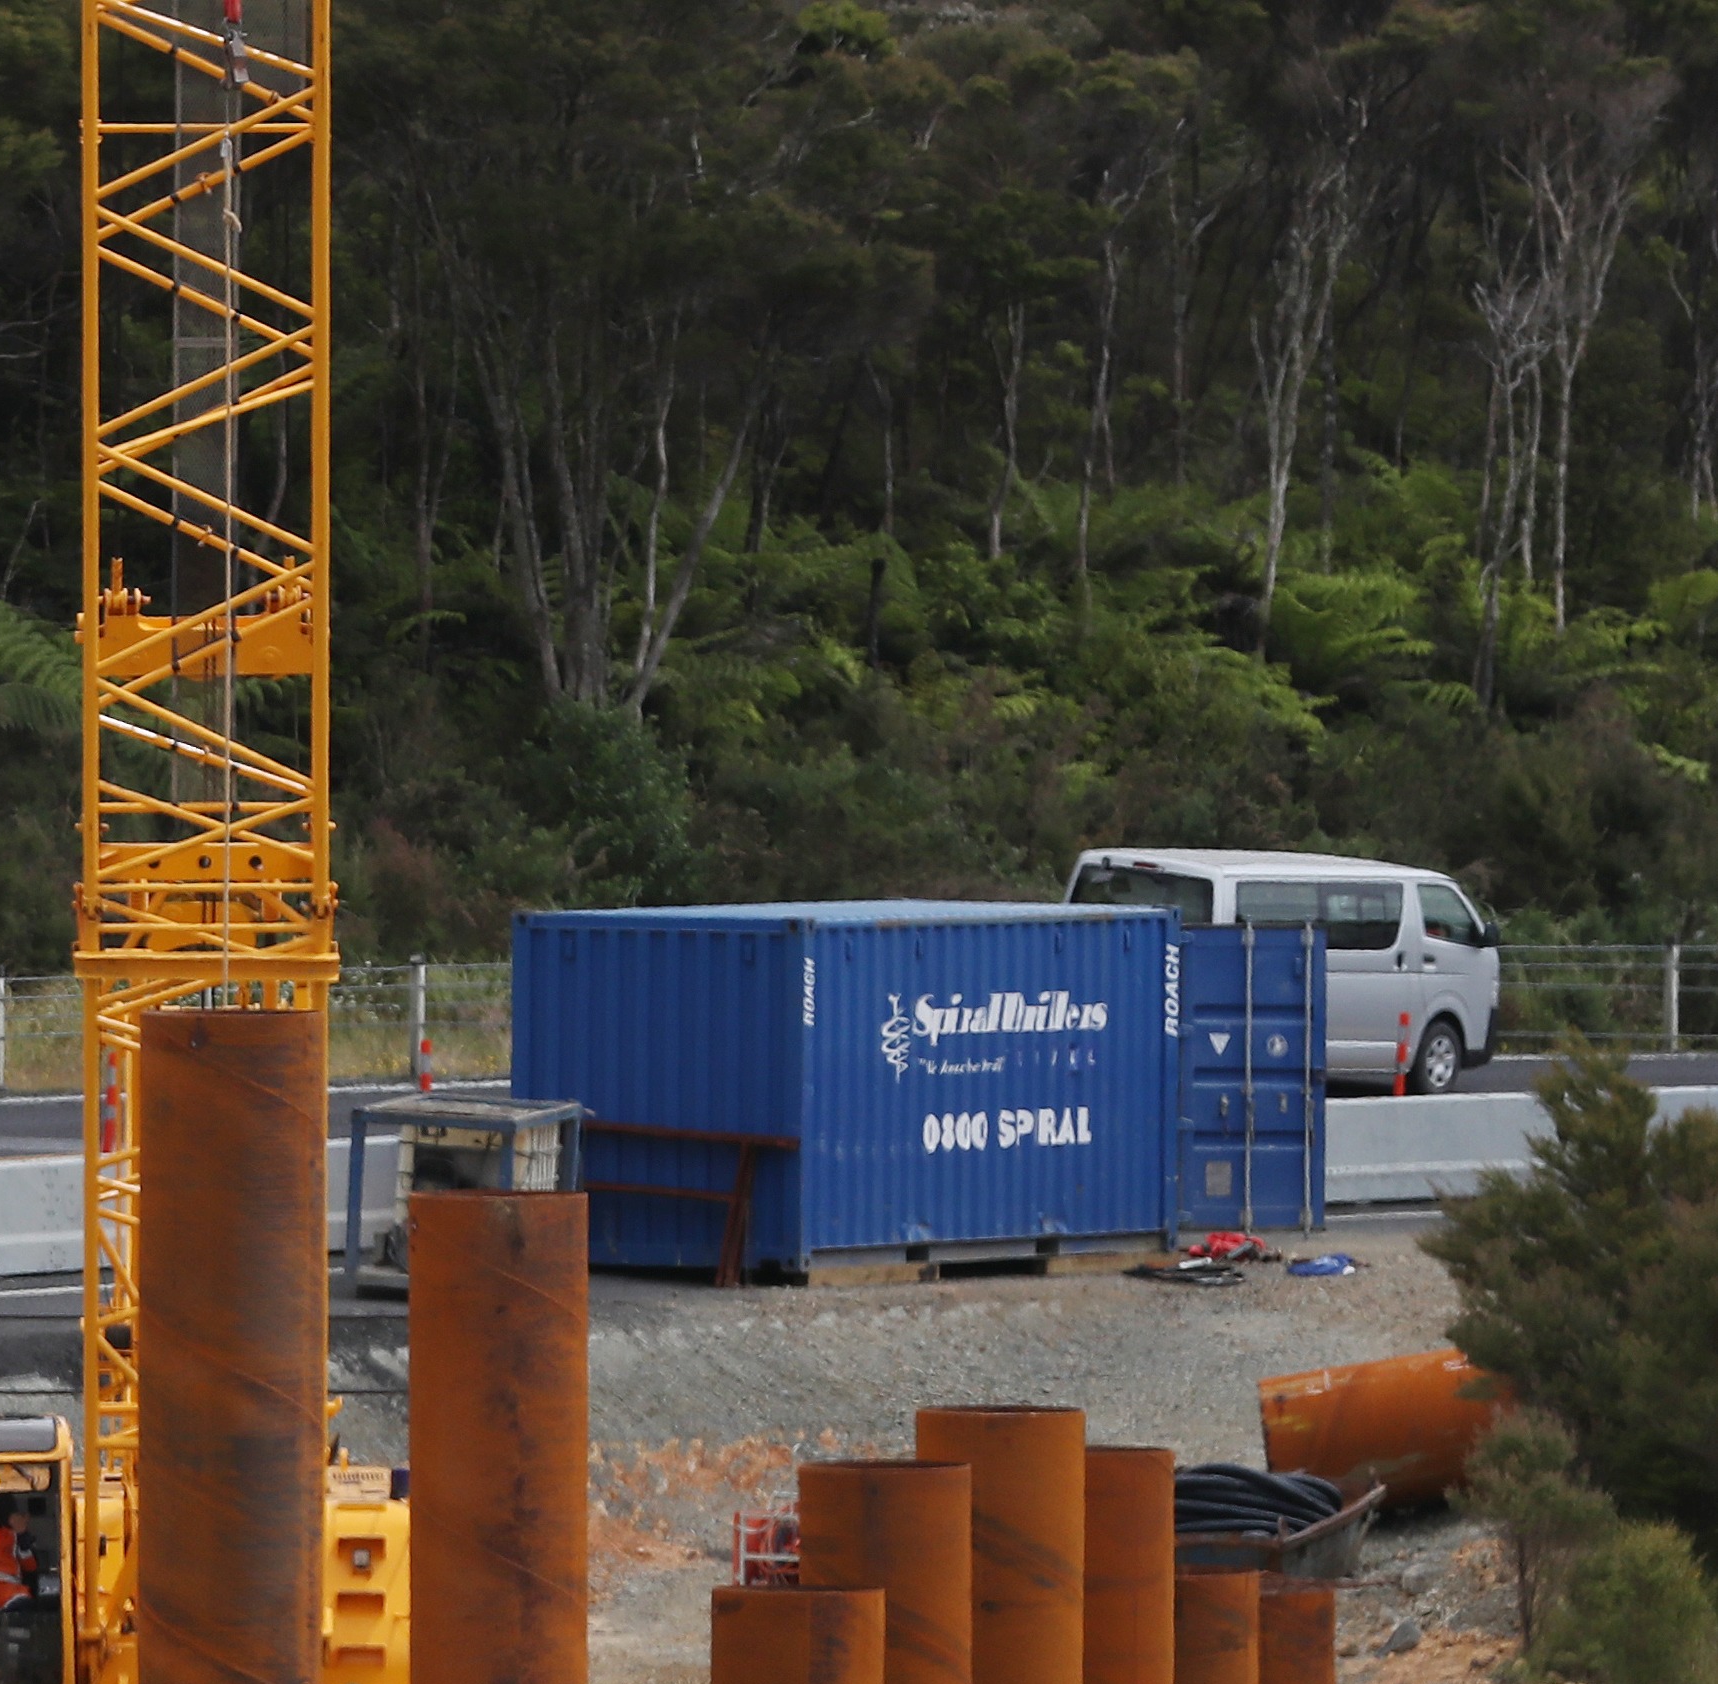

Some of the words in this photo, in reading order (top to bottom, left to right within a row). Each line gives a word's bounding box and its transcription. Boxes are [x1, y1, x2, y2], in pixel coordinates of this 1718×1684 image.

[803, 957, 816, 1027] ROACH
[1164, 943, 1181, 1038] ROACH
[922, 1110, 989, 1155] 0800
[998, 1106, 1092, 1149] SPRAL
